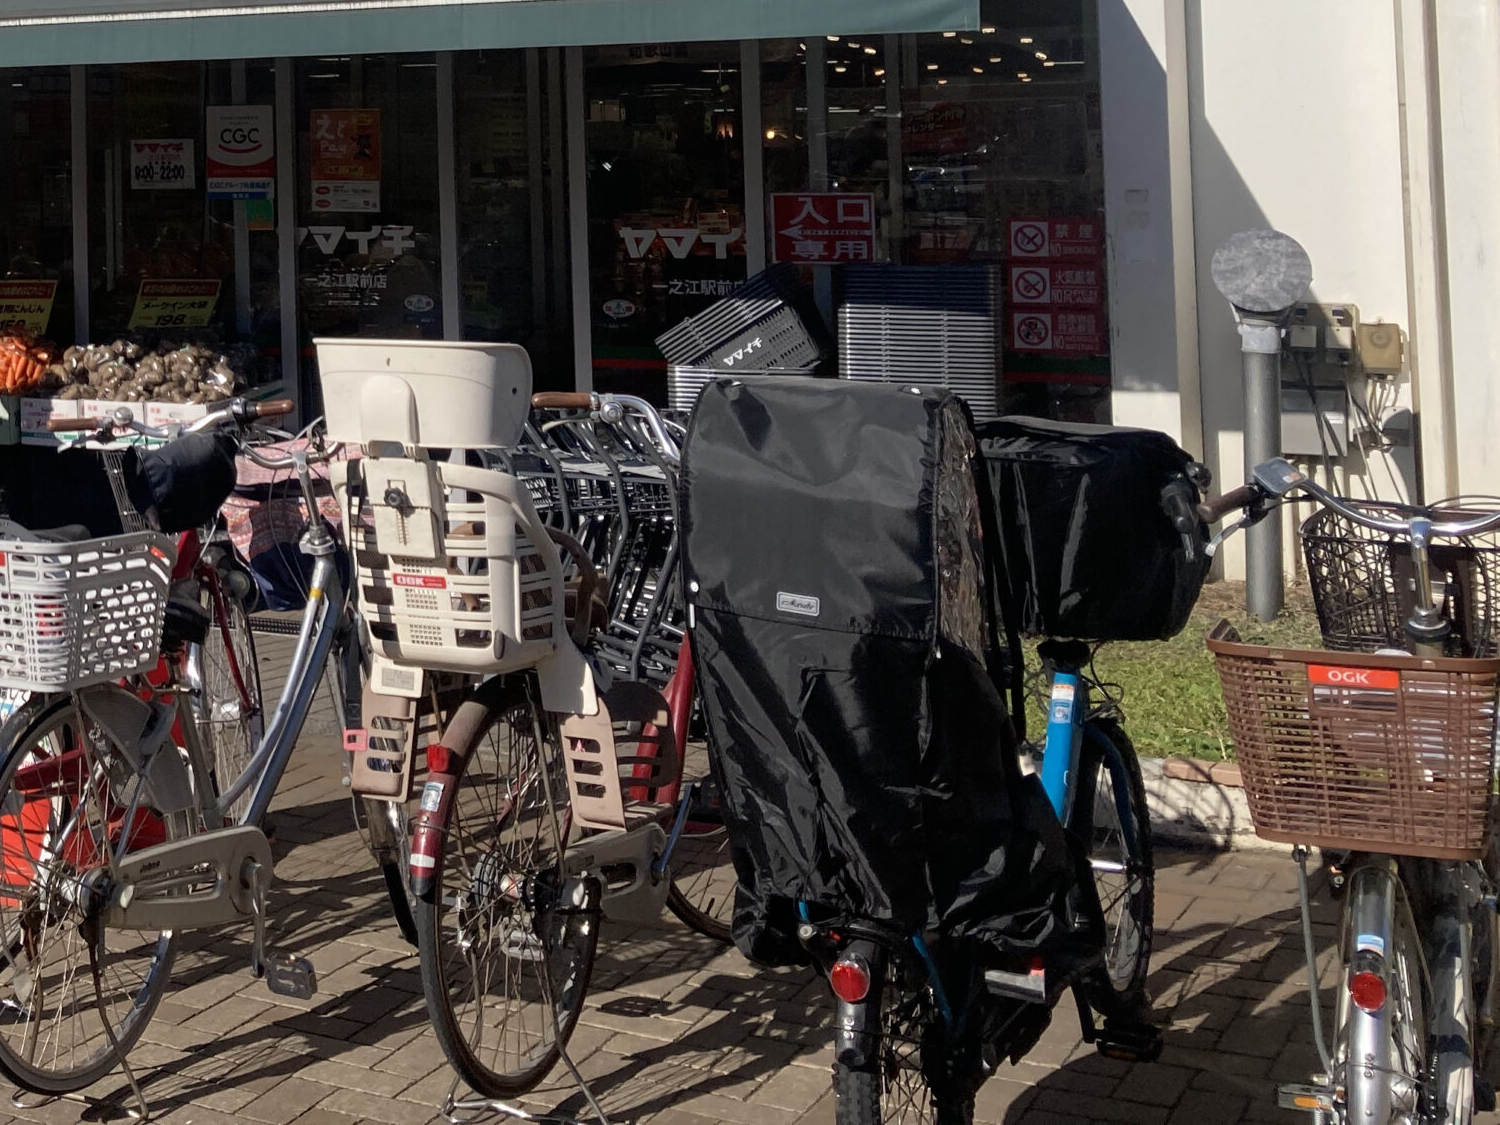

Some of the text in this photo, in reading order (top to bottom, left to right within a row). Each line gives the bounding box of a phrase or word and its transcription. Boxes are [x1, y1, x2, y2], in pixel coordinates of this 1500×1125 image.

[220, 128, 260, 144] CGC
[788, 196, 870, 225] 入口
[790, 240, 869, 260] 専用
[396, 575, 425, 587] OGK
[1327, 669, 1369, 684] OGK
